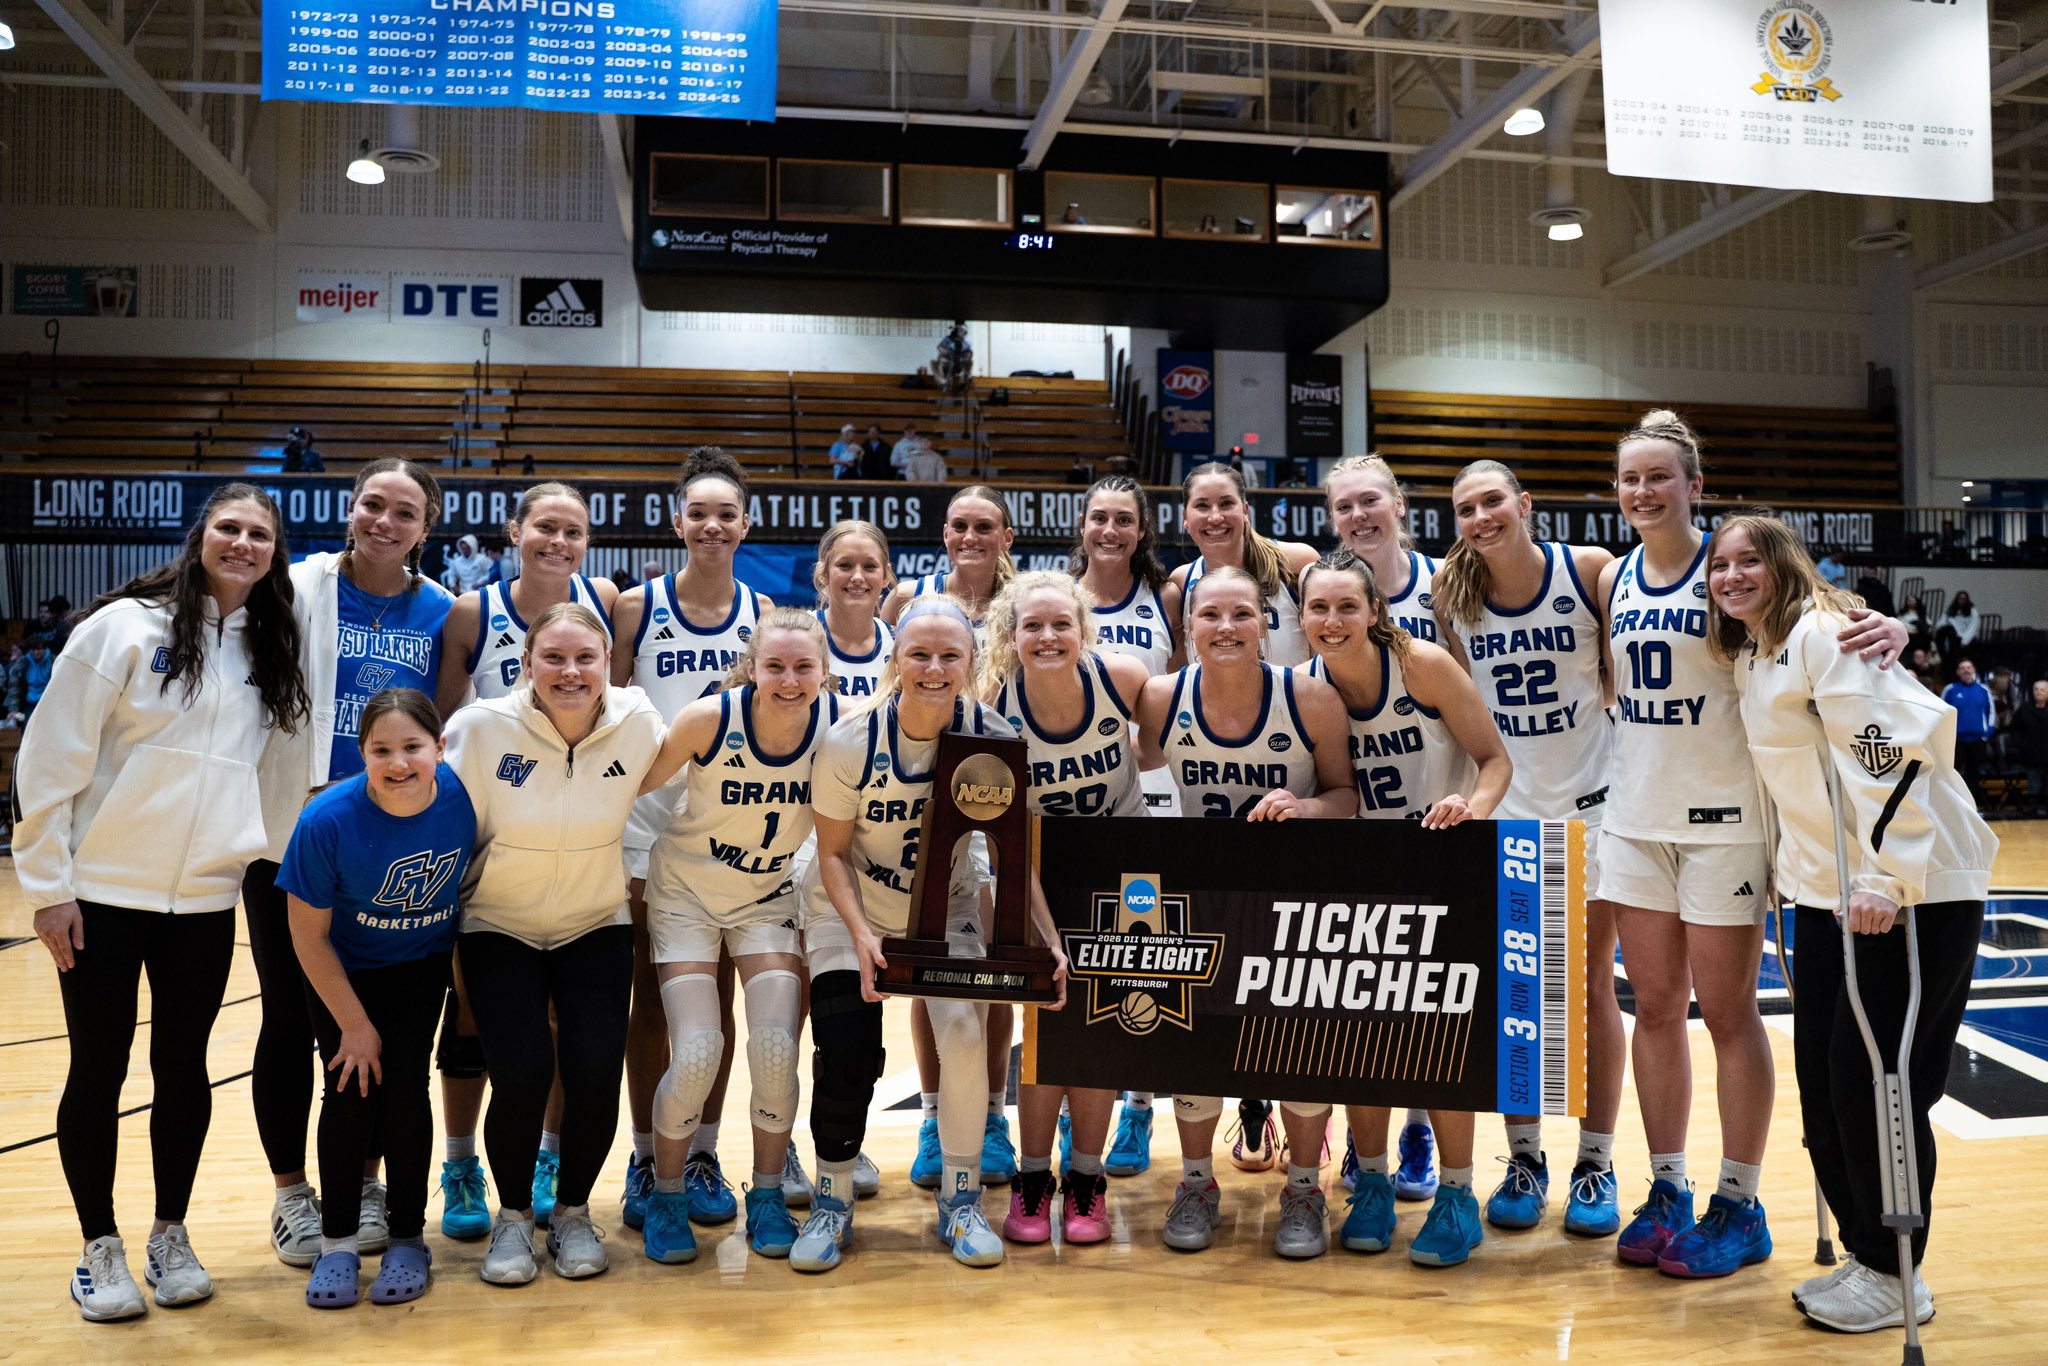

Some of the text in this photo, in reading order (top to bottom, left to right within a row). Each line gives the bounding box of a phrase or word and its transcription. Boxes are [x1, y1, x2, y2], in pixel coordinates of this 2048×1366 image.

[430, 0, 615, 18] CHAMPIONS
[291, 10, 746, 43] 1972-73 1973-74 1974-75 1977-78 1978-79 1998-99
[290, 26, 748, 58] 1999-00 2000-01 2001-02 2002-03 2003-04 2004-05
[288, 43, 745, 74] 2005-06 2006-07 2007-08 2008-09 2009-10 2010-11
[287, 61, 743, 89] 2011-12 2012-13 2013-14 2014-15 2015-16 2016-17
[284, 80, 740, 104] 2017-18 2018-19 2021-22 2022-23 2023-24 2024-25
[1862, 120, 1915, 132] 2007-08
[1922, 125, 1974, 136] 2008-09
[670, 230, 728, 244] NovaCare
[731, 230, 828, 243] Official Provider of
[731, 243, 818, 258] Physical Therapy
[1018, 234, 1053, 249] 8:41
[299, 283, 379, 313] meijer
[403, 284, 499, 317] DTE
[527, 309, 596, 327] adidas
[1172, 373, 1203, 394] DQ
[33, 479, 183, 519] LONG ROAD
[589, 493, 626, 526] OF
[750, 494, 921, 529] ATHLETICS
[1003, 490, 1086, 528] NG ROA
[60, 519, 156, 528] DISTILLERS
[1780, 511, 1873, 545] ONG ROAD
[896, 554, 950, 574] NCA
[382, 628, 427, 636] BASKETBALL
[1610, 608, 1707, 639] GRAND
[370, 633, 433, 677] LAKERS
[1470, 625, 1576, 661] GRAND
[355, 662, 396, 693] GV
[1625, 641, 1672, 690] 10
[1491, 659, 1559, 706] 22
[1618, 695, 1706, 725] VALLEY
[727, 739, 744, 747] NCAA
[496, 753, 539, 787] GV
[1181, 759, 1288, 790] GRAND
[721, 780, 811, 805] GRAN
[956, 783, 1013, 806] NCAA
[1038, 783, 1107, 817] 20
[1356, 765, 1408, 811] 12
[761, 811, 780, 850] 1
[372, 848, 461, 912] GV
[1127, 895, 1156, 905] NCAA
[1097, 935, 1121, 943] 2026
[1141, 936, 1184, 945] WOMEN'S
[1272, 901, 1448, 955] TICKET
[1077, 943, 1209, 971] ELITE EIGHT
[1503, 836, 1537, 1104] SECTION 3 ROW 28 SEAT 26
[922, 969, 1025, 987] REGIONAL CHAMPION
[1110, 979, 1169, 988] PITTSBURGH
[1235, 956, 1480, 1014] PUNCHED
